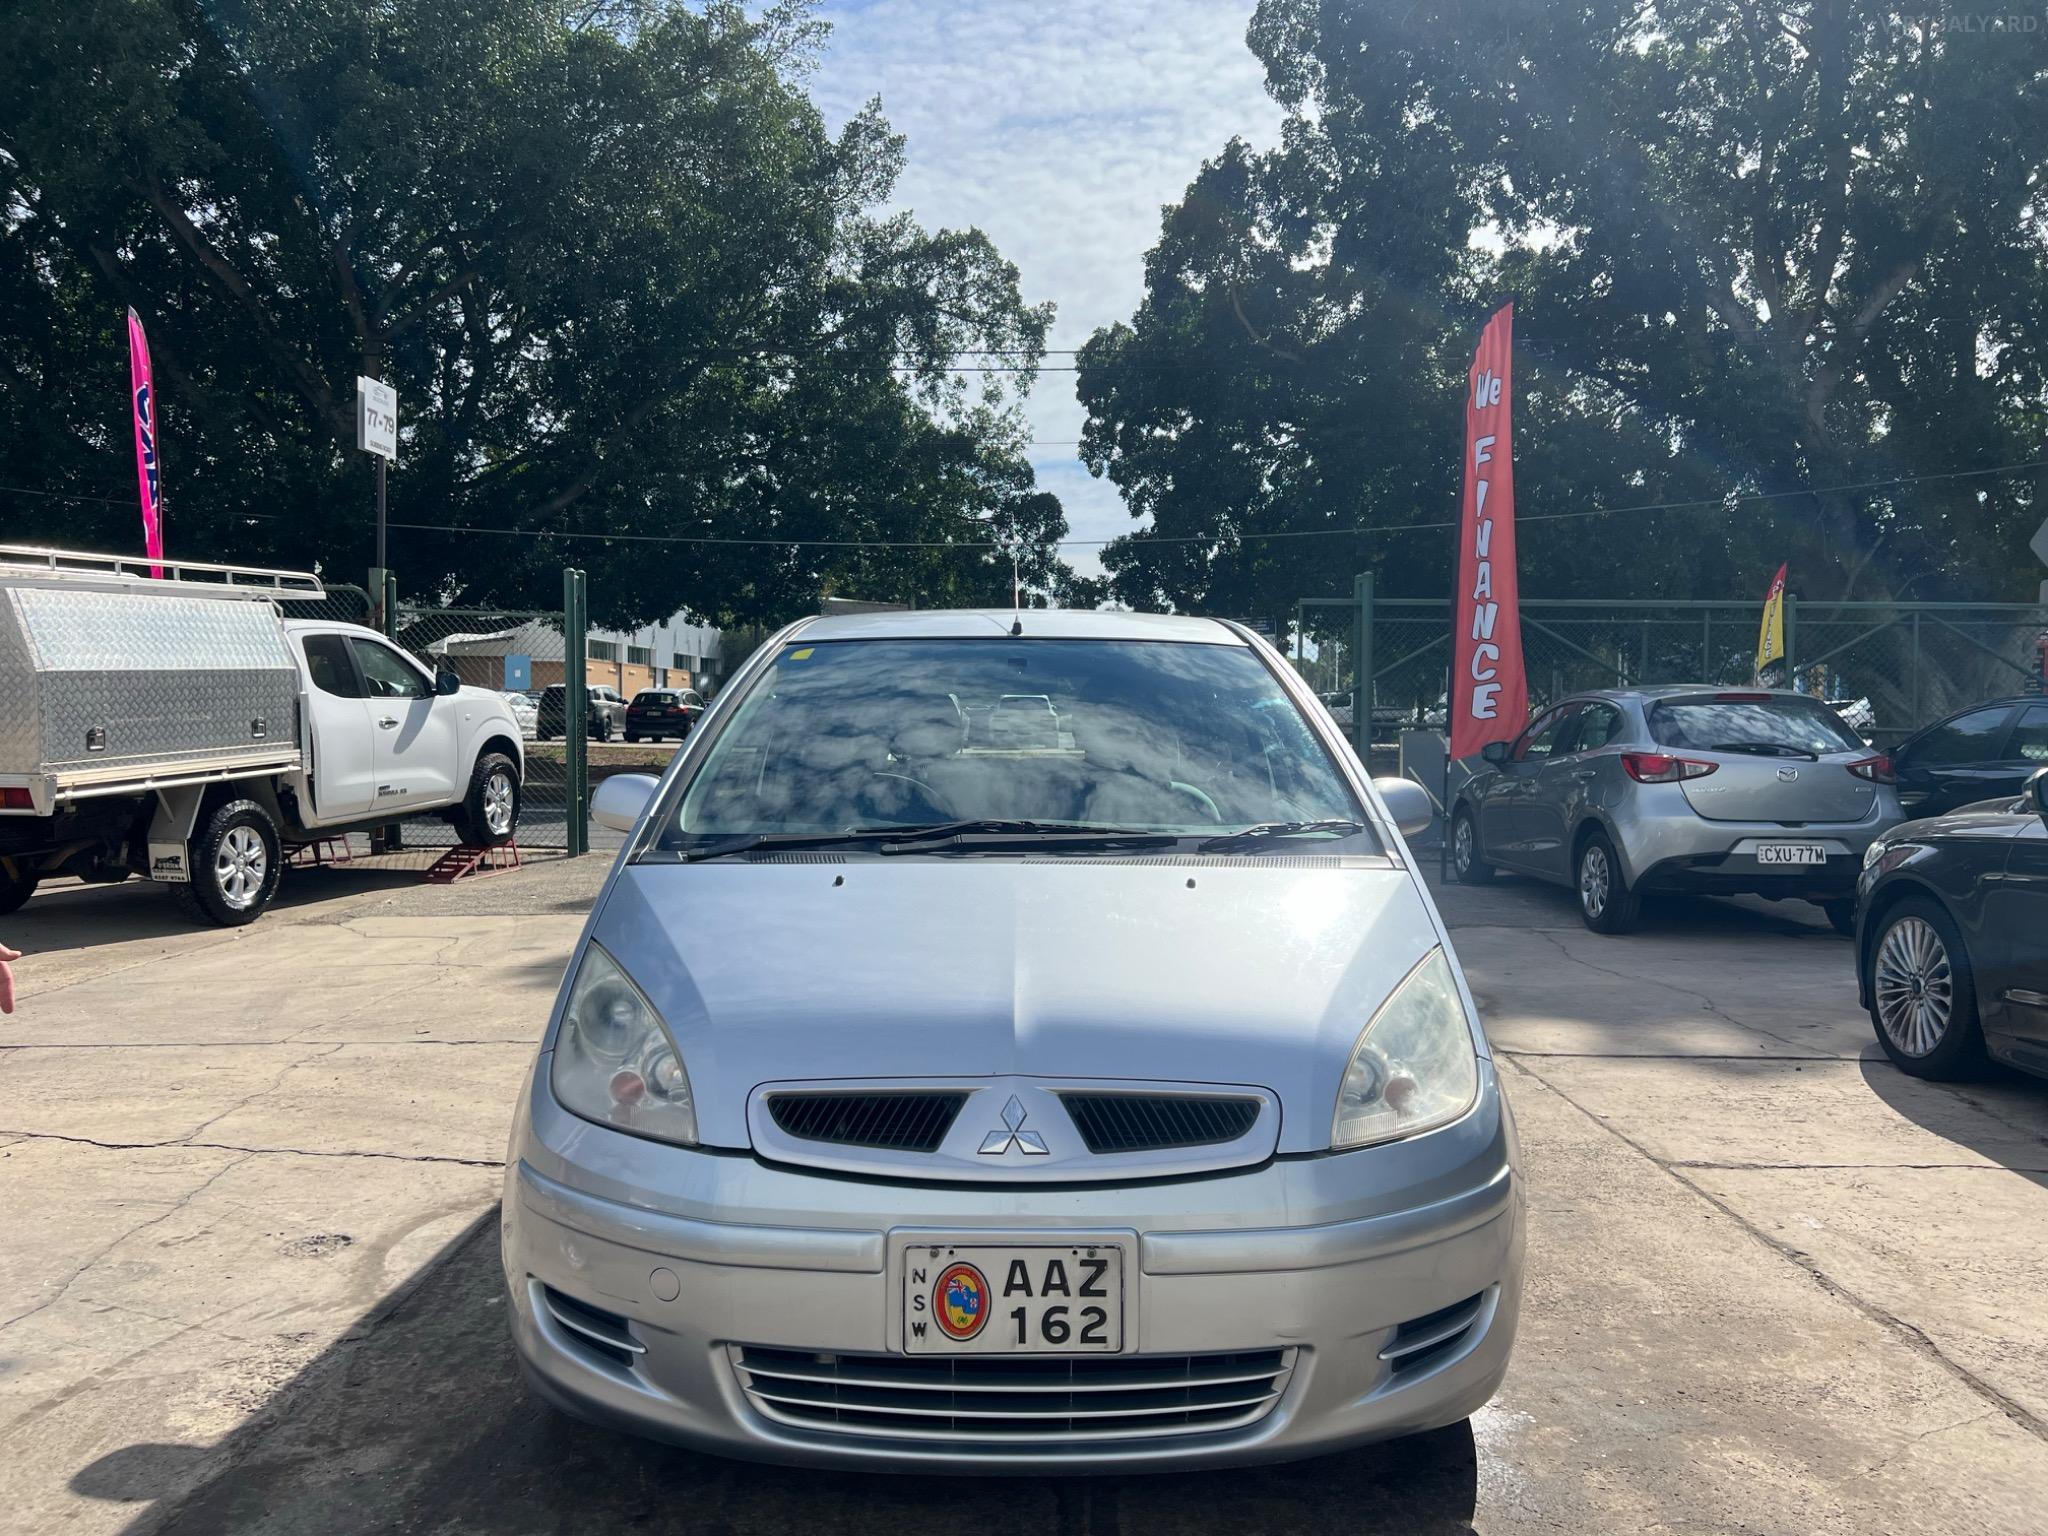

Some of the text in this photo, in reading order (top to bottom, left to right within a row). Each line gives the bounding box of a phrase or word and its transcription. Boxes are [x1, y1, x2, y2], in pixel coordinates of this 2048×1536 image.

[1475, 368, 1501, 410] We
[1471, 435, 1502, 720] FINANCE
[1003, 1259, 1108, 1297] AAZ
[1010, 1305, 1108, 1344] 162
